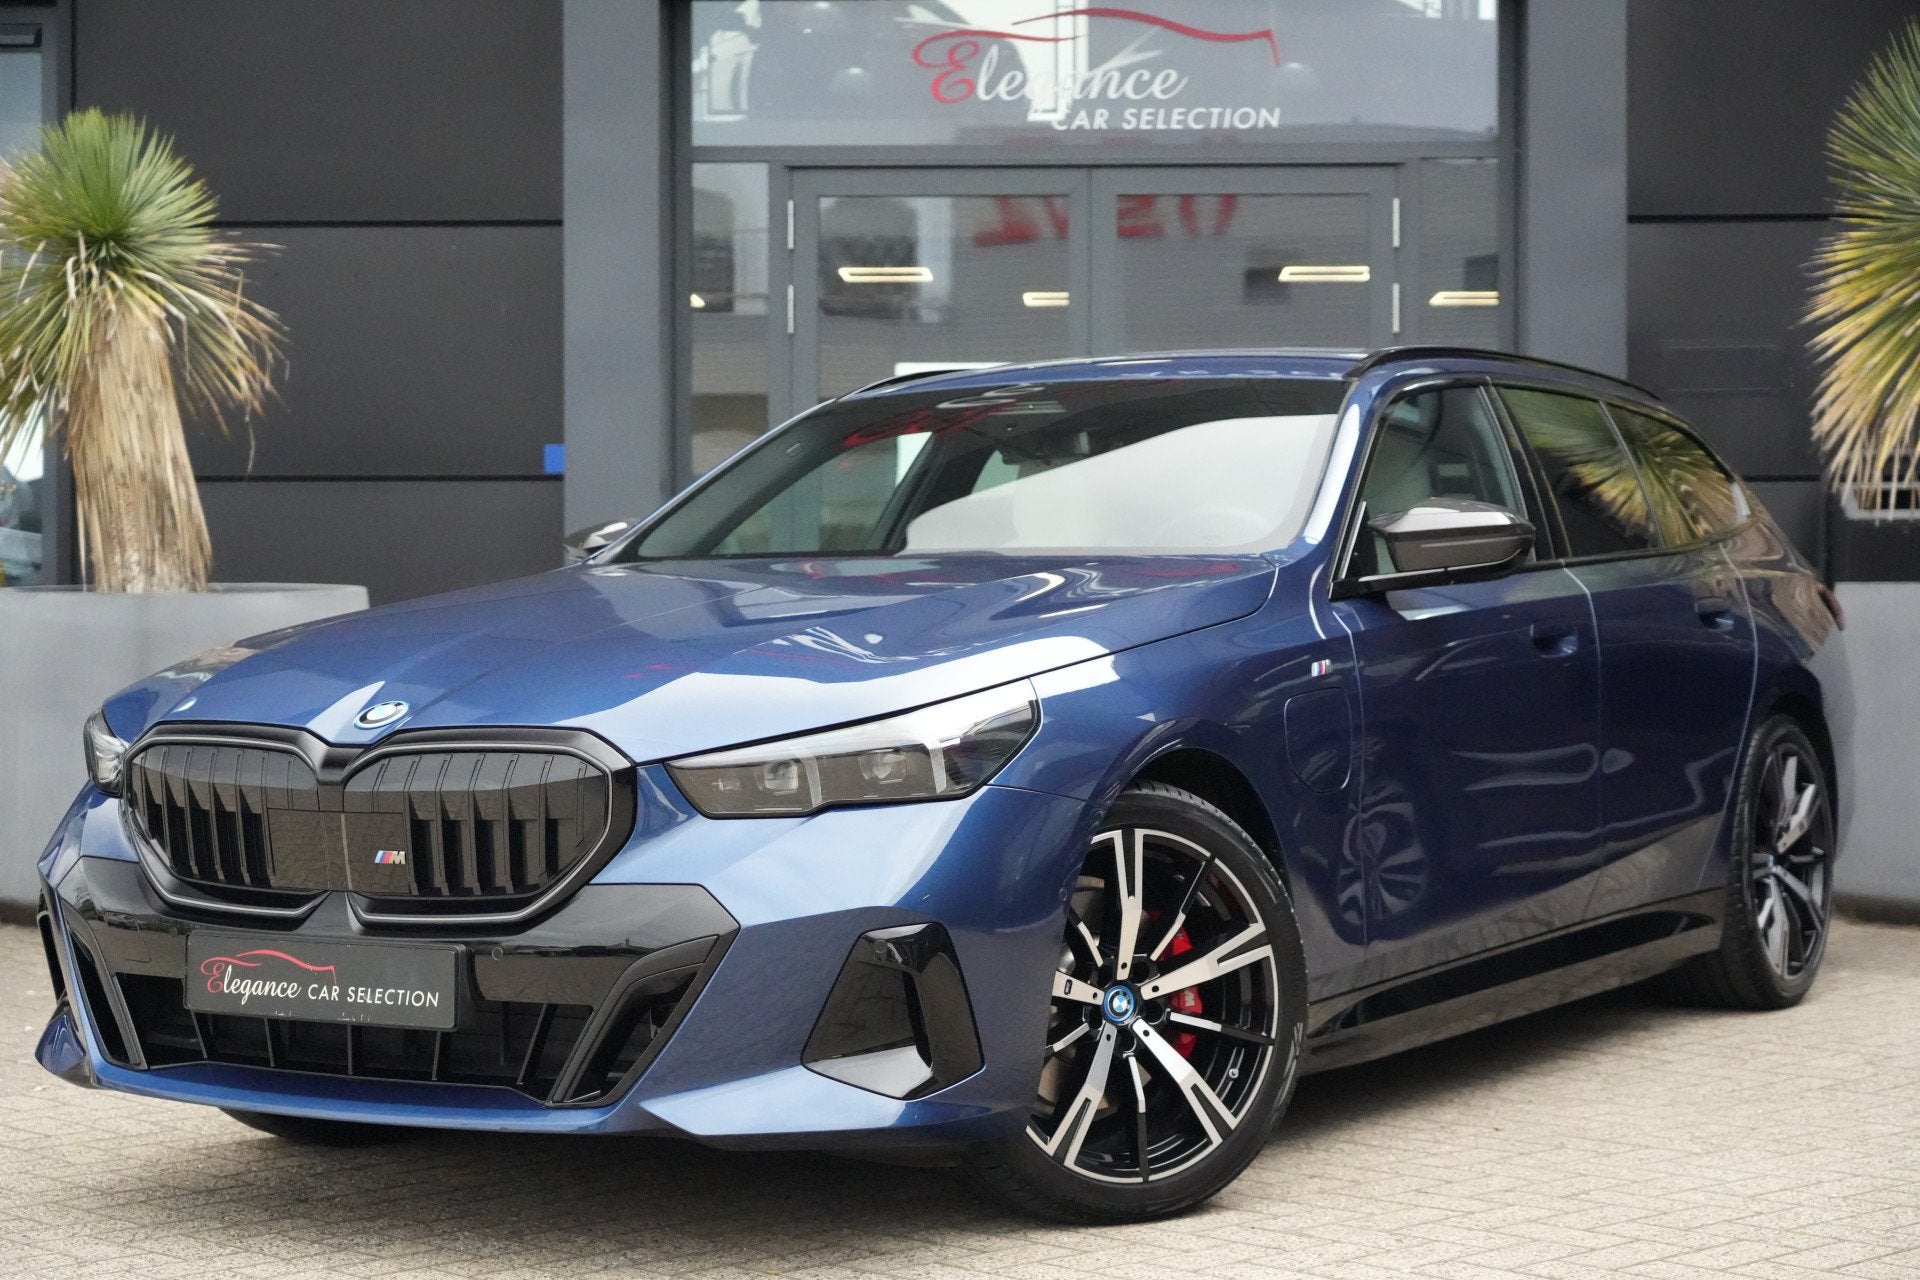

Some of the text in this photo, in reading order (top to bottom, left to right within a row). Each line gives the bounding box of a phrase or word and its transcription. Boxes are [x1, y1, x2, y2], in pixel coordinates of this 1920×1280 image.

[912, 36, 1189, 108] Elence
[1121, 106, 1282, 131] SELECTION
[201, 958, 441, 1009] Elegance CAR SELECTION
